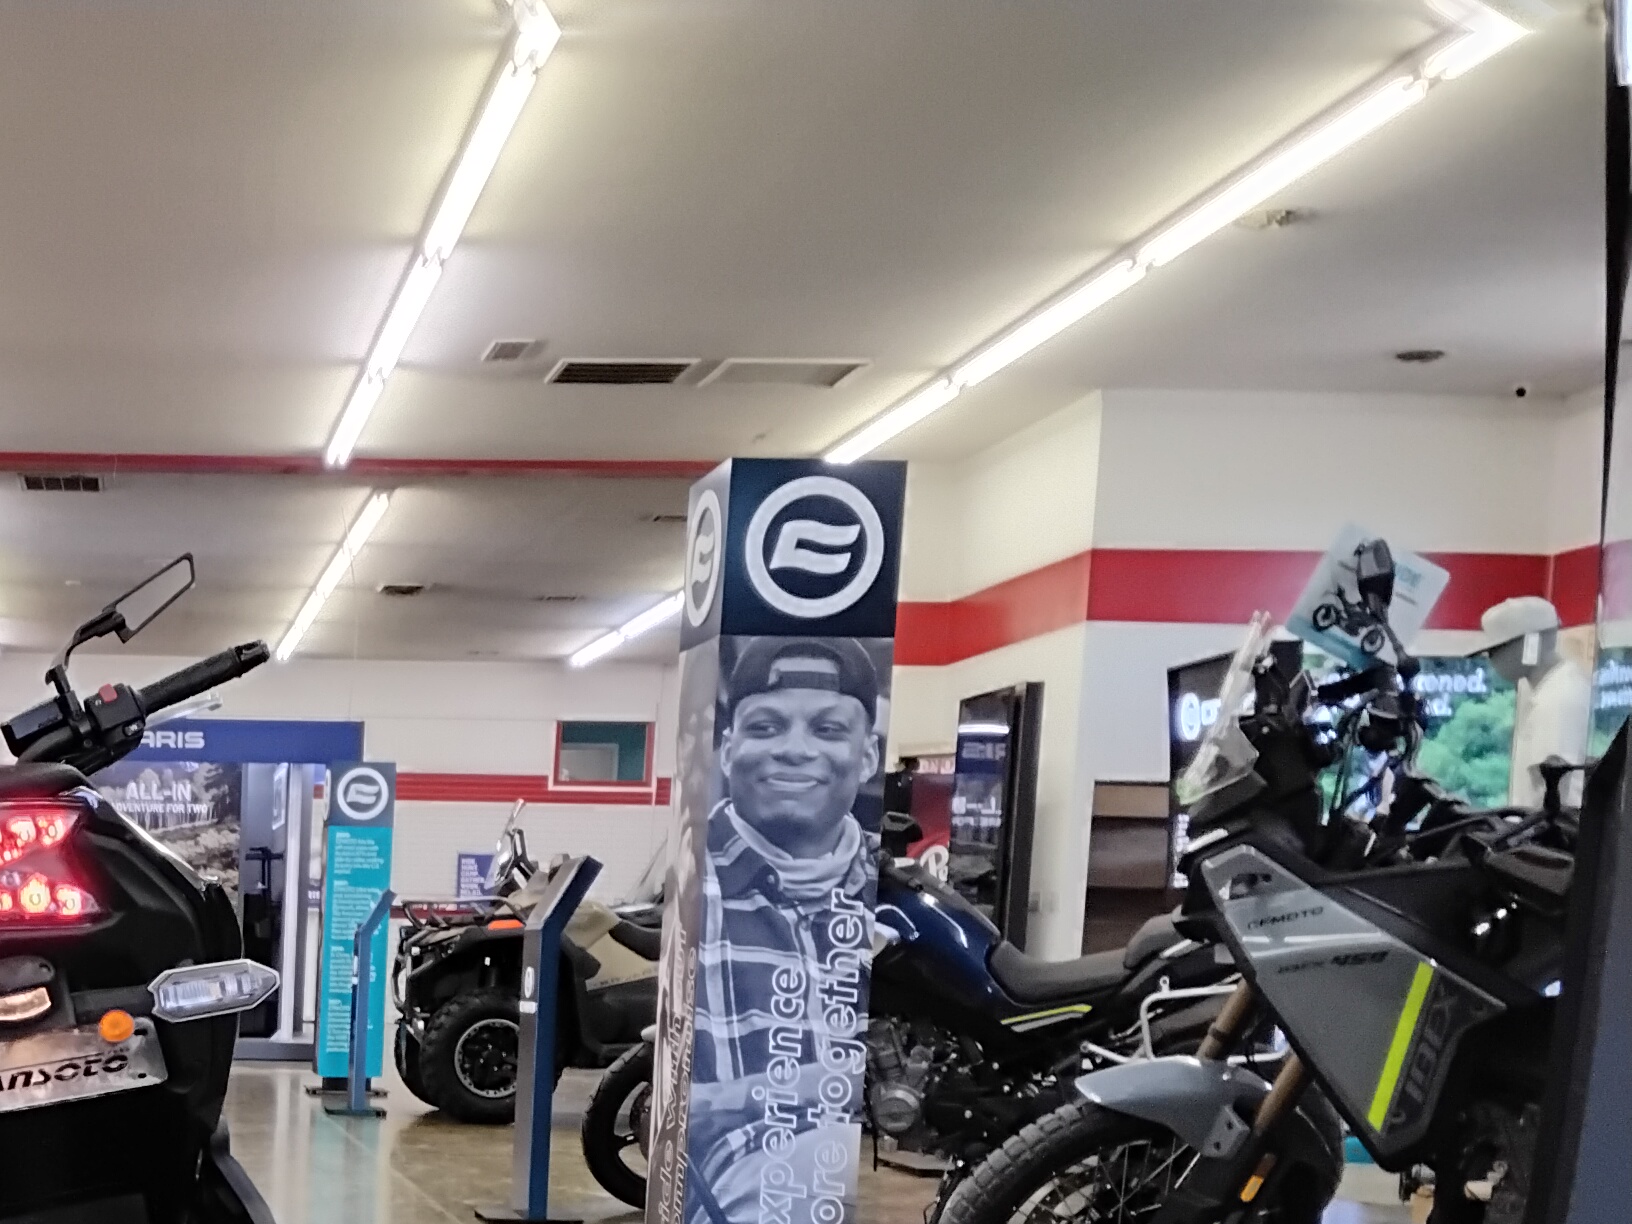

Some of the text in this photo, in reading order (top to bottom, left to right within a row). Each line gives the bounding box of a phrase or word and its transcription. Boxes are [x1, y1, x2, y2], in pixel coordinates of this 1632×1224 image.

[140, 731, 205, 749] ARIS
[126, 781, 192, 802] ALL-IN
[166, 804, 186, 814] FOR
[187, 804, 208, 814] TWO
[808, 887, 866, 1129] together
